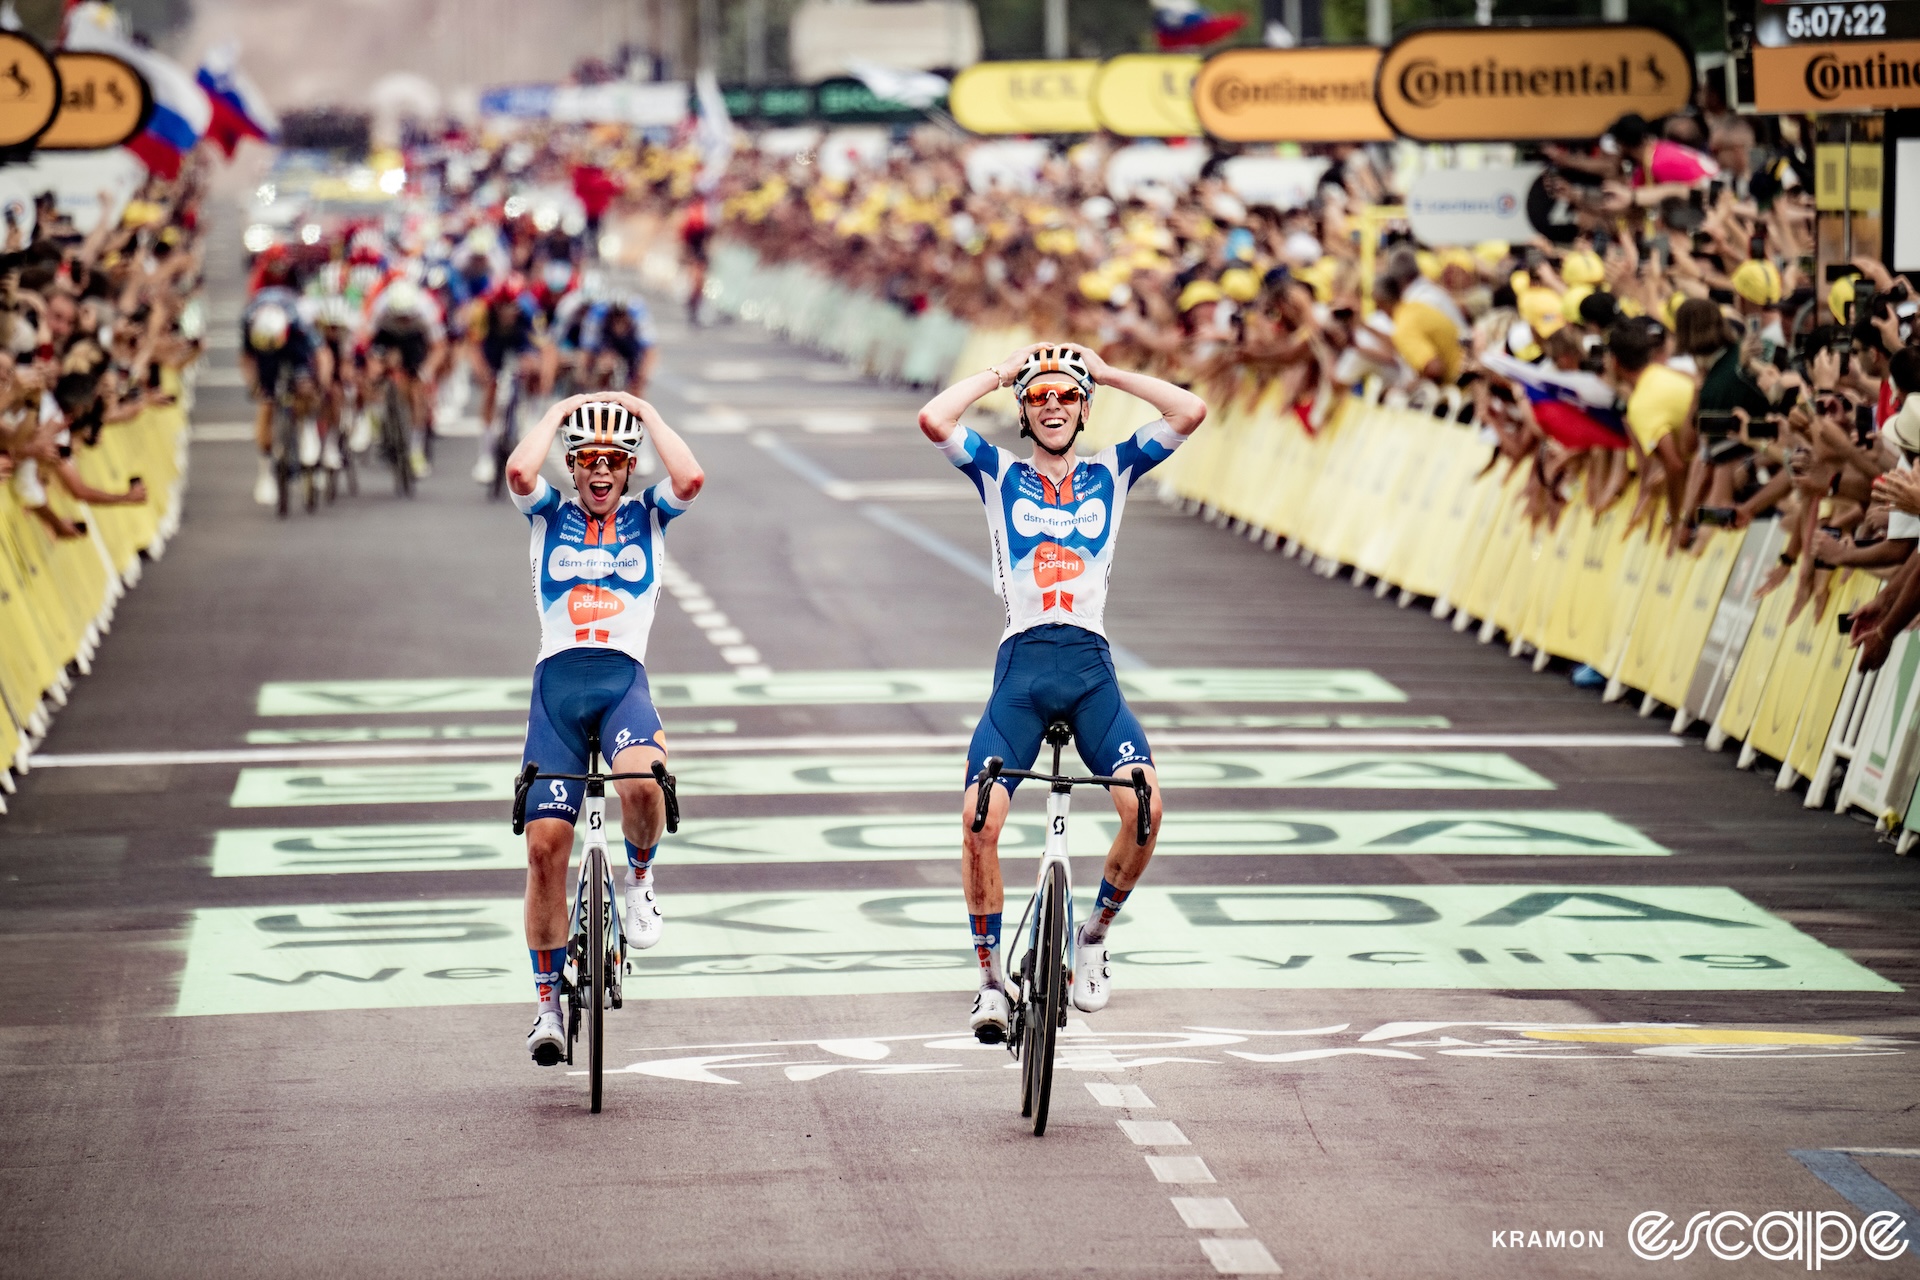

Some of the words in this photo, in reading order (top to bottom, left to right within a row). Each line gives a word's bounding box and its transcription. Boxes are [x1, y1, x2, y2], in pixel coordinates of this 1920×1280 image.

[1786, 5, 1886, 38] 5:07:22
[1399, 55, 1632, 107] Continental
[1018, 484, 1043, 501] zoover
[1023, 512, 1098, 527] dsm-firmenich
[559, 532, 583, 544] zoover
[558, 558, 639, 569] dsm-firmenich
[1038, 559, 1080, 573] postnl
[573, 600, 618, 612] postnl
[611, 738, 649, 760] SCOTT
[1111, 755, 1149, 769] SCOTT
[537, 802, 578, 815] SCOTT
[1110, 947, 1791, 970] cycling
